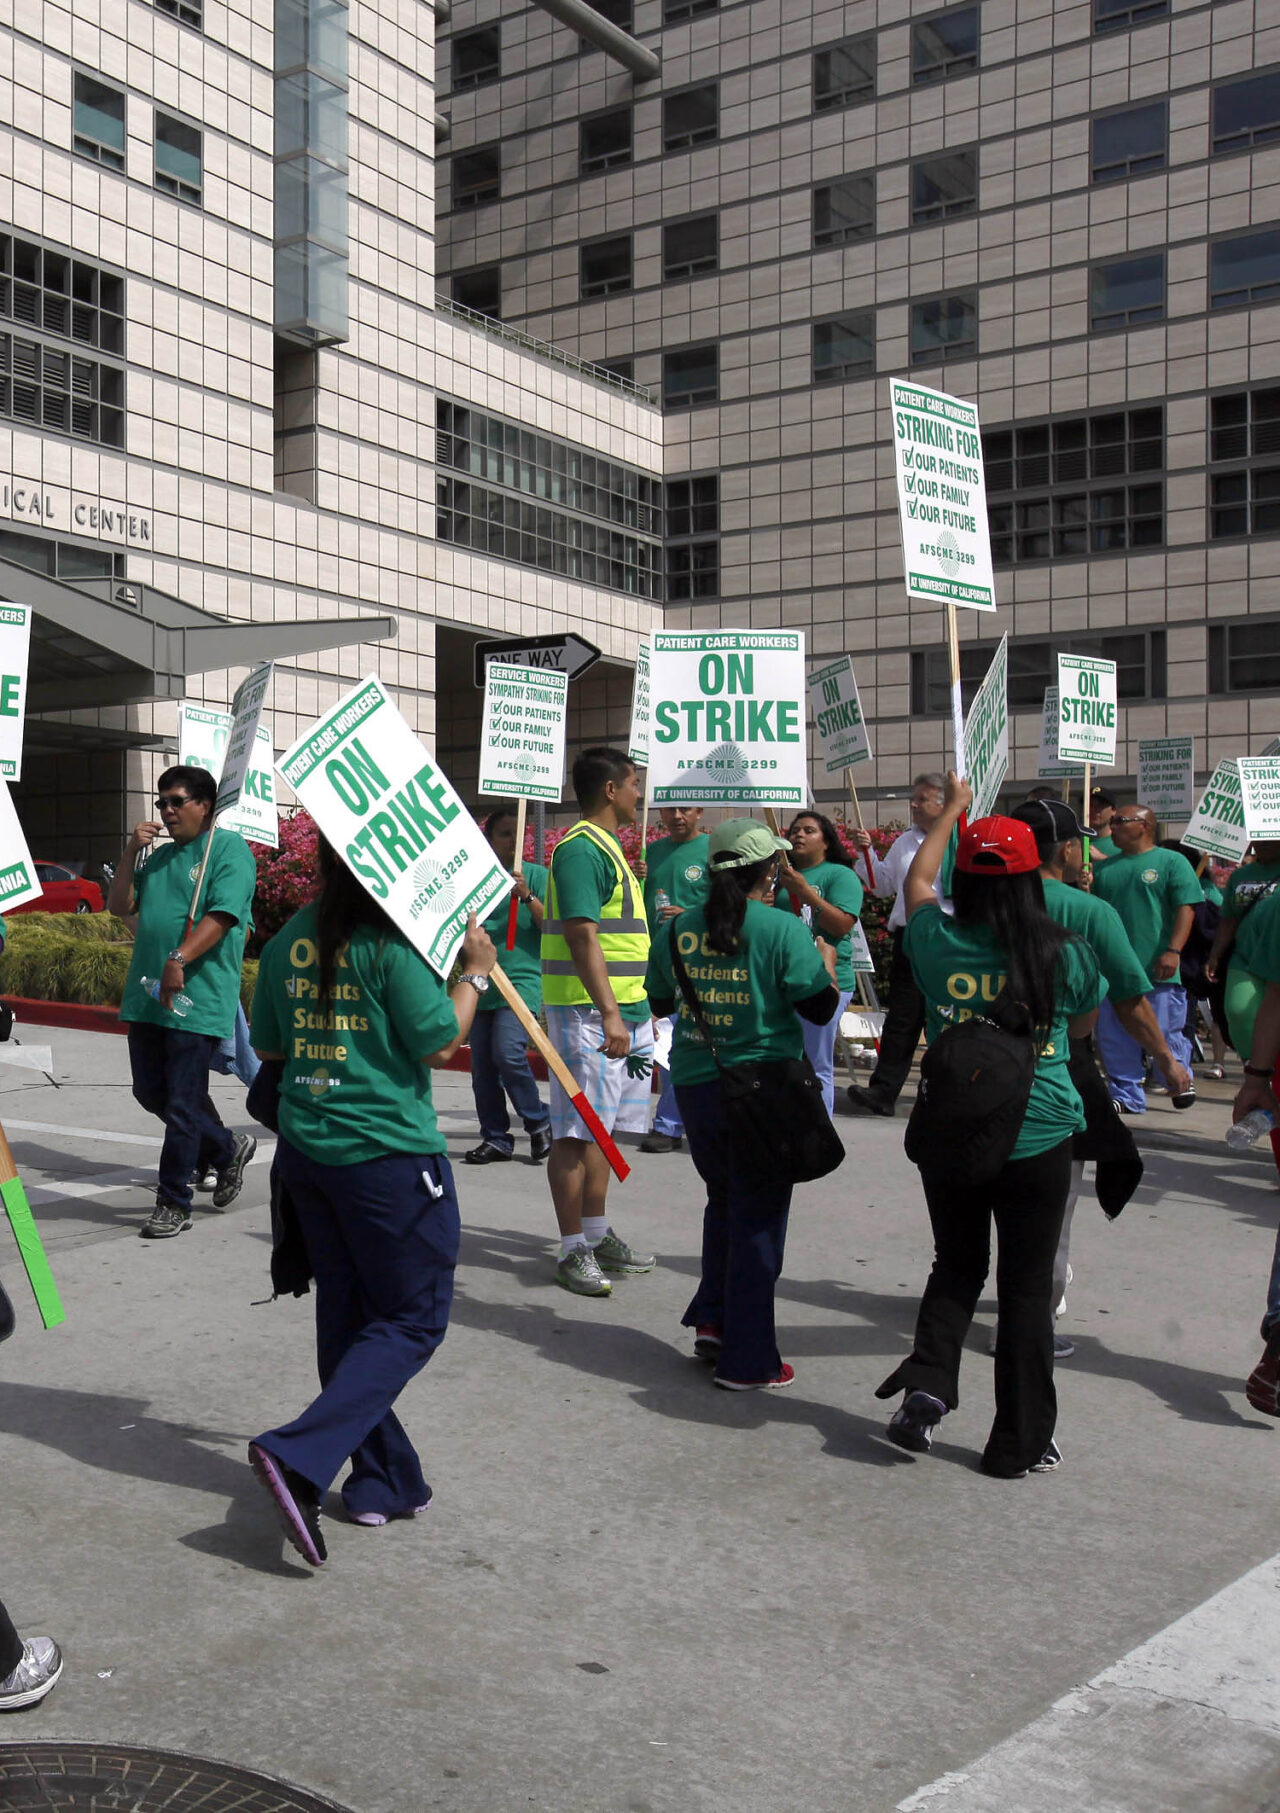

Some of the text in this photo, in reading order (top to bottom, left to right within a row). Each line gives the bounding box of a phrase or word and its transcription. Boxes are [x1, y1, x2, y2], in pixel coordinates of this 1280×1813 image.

[895, 389, 974, 424] PATIENT CARE WORKERS
[896, 412, 979, 459] STRIKING FOR
[915, 453, 978, 485] OUR PATIENTS
[917, 479, 969, 507] OUR FAMILY
[75, 504, 151, 540] CENTER
[919, 504, 976, 532] OUR FUTURE
[920, 543, 975, 565] AFSCME 3299
[919, 579, 950, 597] UNIVERSITY
[952, 584, 958, 595] OF
[959, 585, 990, 602] CALIFORNIA
[656, 636, 797, 648] PATIENT CARE WORKERS
[528, 649, 563, 667] WAY
[490, 668, 564, 687] SERVICE WORKERS
[698, 653, 754, 695] ON
[1078, 671, 1099, 698] ON
[489, 683, 564, 705] SYMPATHY STRIKING FOR
[822, 677, 840, 706] ON
[503, 704, 561, 722] OUR PATIENTS
[655, 701, 799, 743] STRIKE
[818, 699, 861, 738] STRIKE
[1061, 697, 1114, 728] STRIKE
[285, 748, 315, 785] PATIENT
[315, 726, 337, 755] CARE
[335, 687, 381, 733] WORKERS
[502, 720, 551, 737] OUR FAMILY
[501, 738, 553, 754] OUR FUTURE
[1140, 748, 1191, 762] STRIKING FOR
[325, 737, 391, 816] ON
[498, 761, 530, 771] AFSCME
[677, 760, 777, 769] AFSCME 3299
[1243, 770, 1280, 780] STRIK
[656, 790, 799, 800] AT UNIVERSITY OF CALIFORNIA
[1211, 771, 1241, 796] SYMP
[1199, 791, 1245, 828] STRIK
[346, 764, 461, 898] STRIKE
[442, 849, 468, 880] 3299
